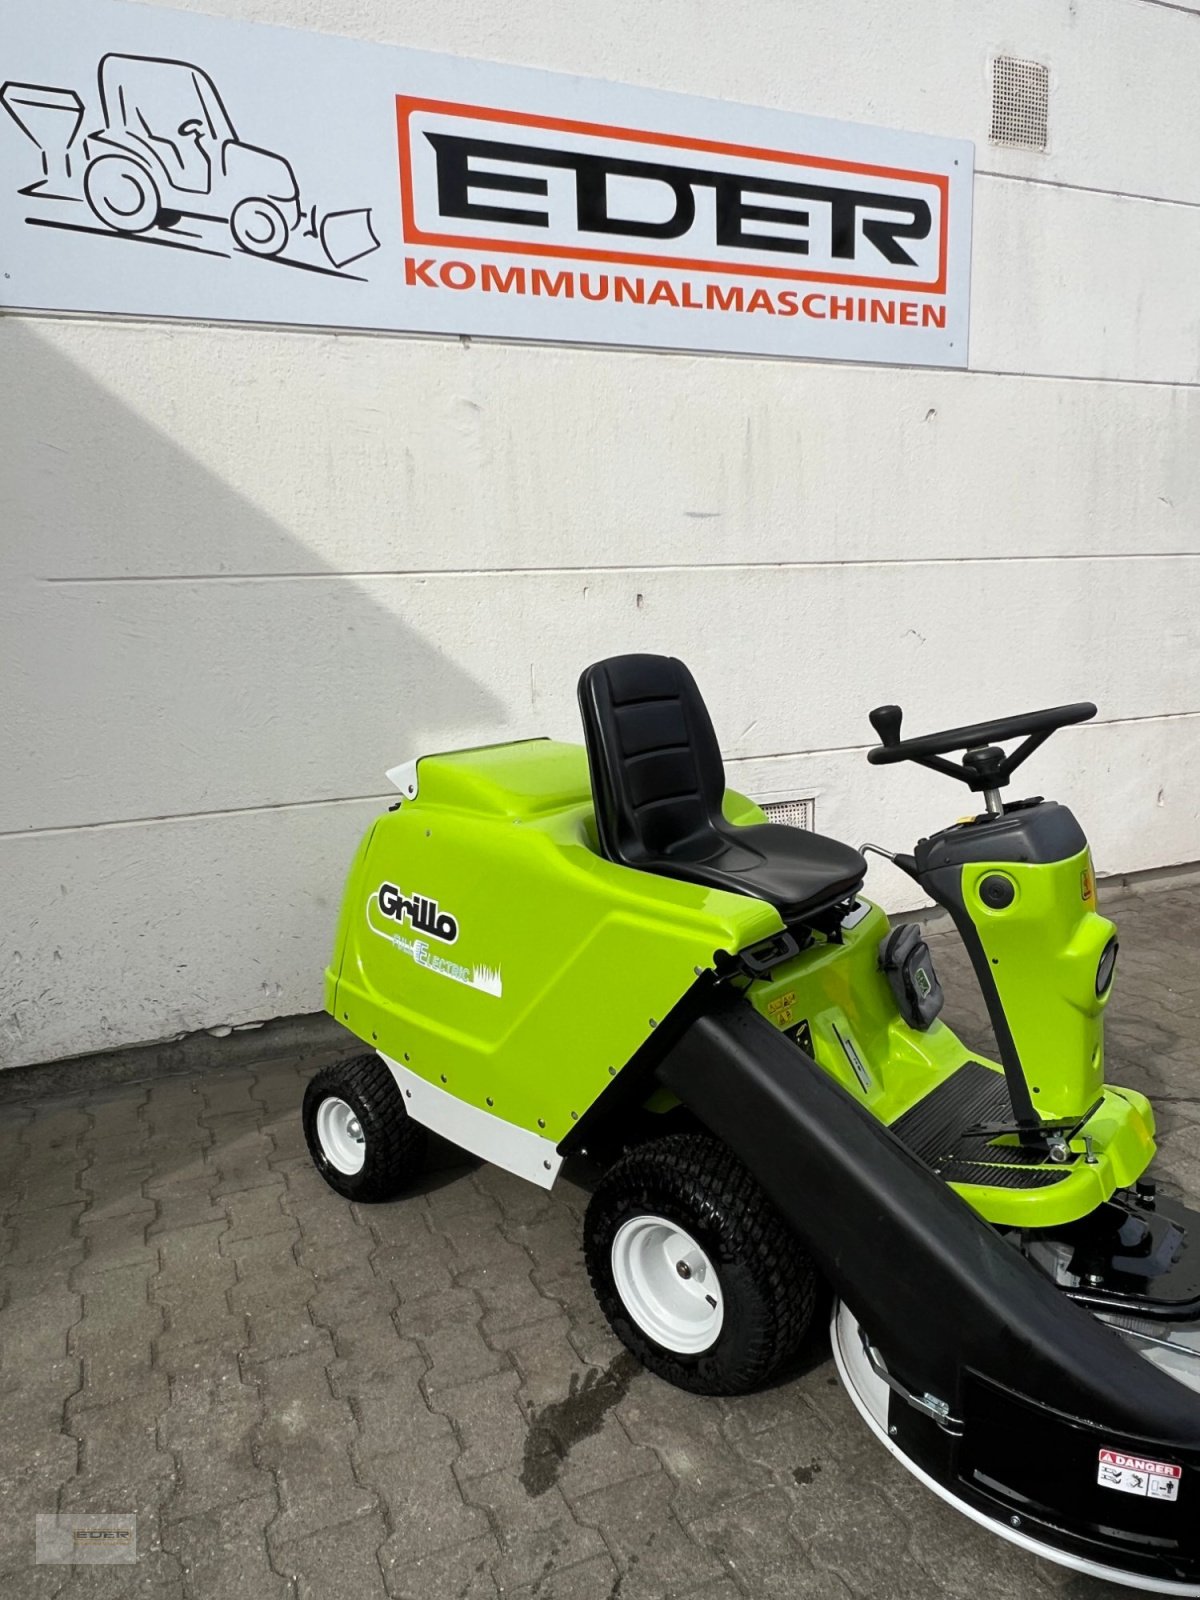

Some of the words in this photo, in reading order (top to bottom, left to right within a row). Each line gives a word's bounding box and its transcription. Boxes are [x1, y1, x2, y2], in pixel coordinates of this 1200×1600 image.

[422, 131, 932, 266] EDER
[404, 257, 946, 328] KOMMUNALMASCHINEN
[378, 883, 458, 942] Grillo
[1115, 1455, 1174, 1475] DANGER
